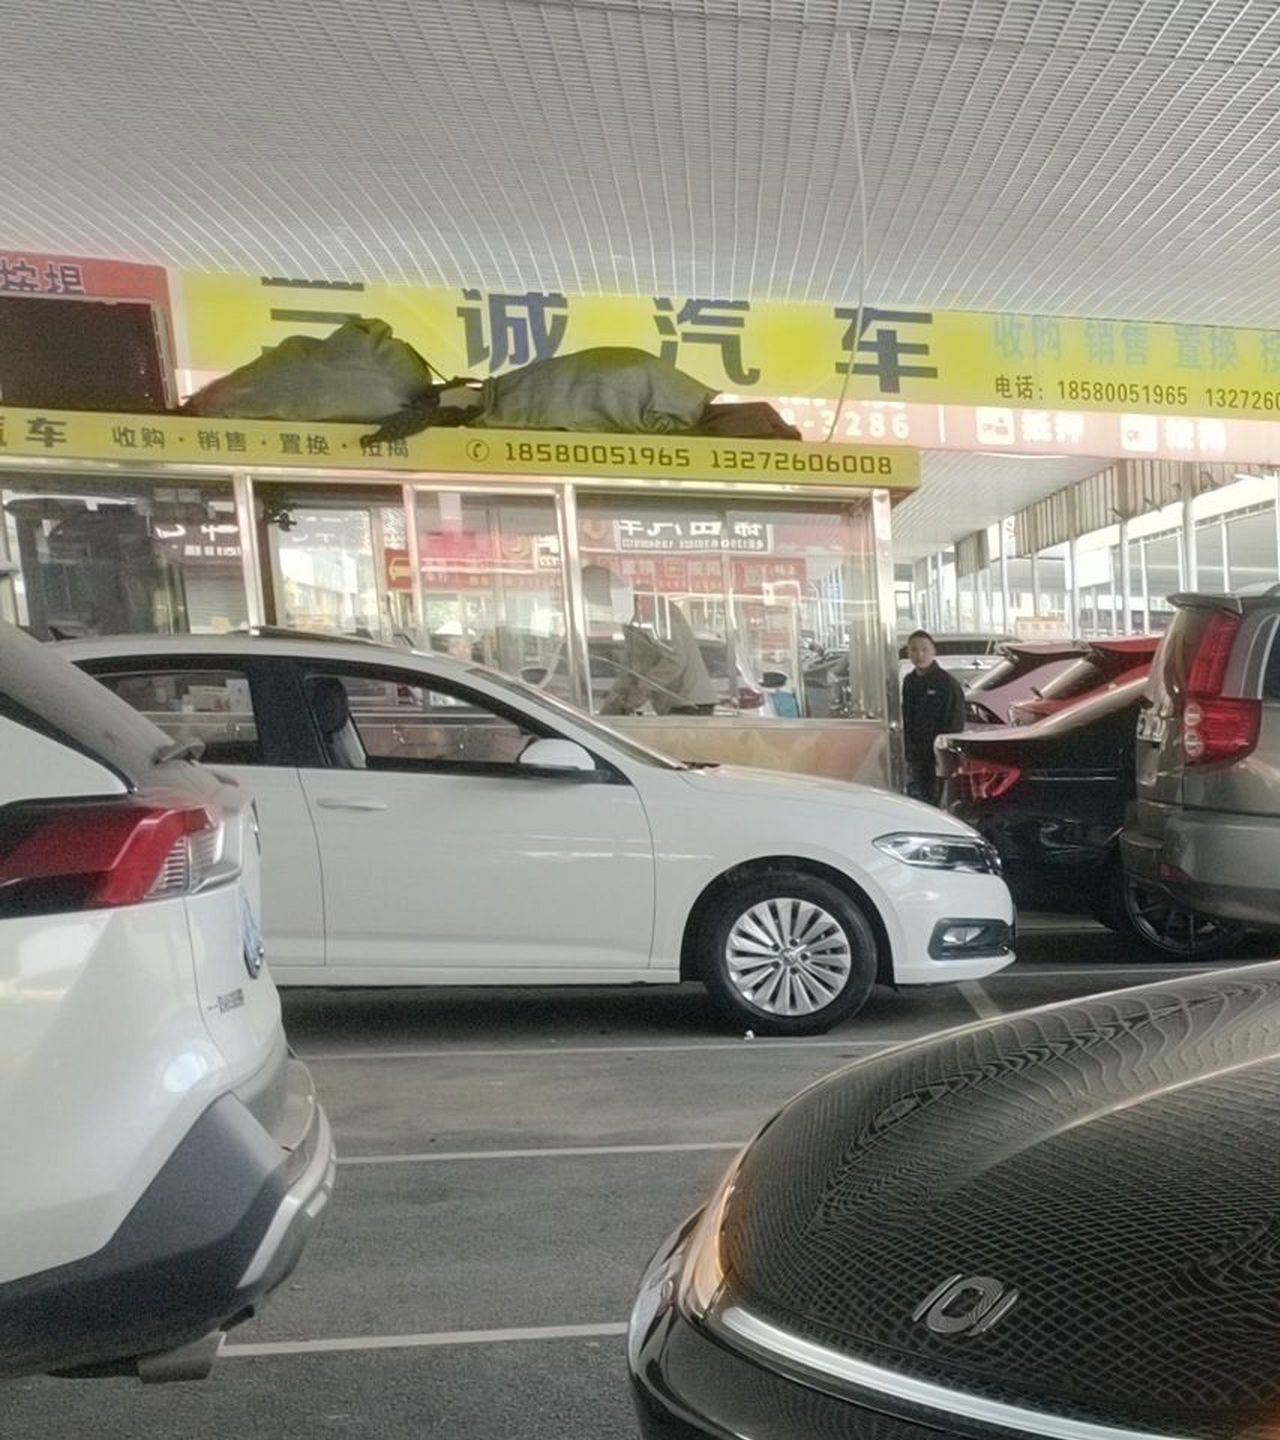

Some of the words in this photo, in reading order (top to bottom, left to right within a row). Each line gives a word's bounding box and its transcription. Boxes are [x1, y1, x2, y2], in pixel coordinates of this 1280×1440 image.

[1057, 380, 1188, 406] 18580051965
[505, 442, 691, 468] 18580051965
[711, 449, 892, 475] 13272606008
